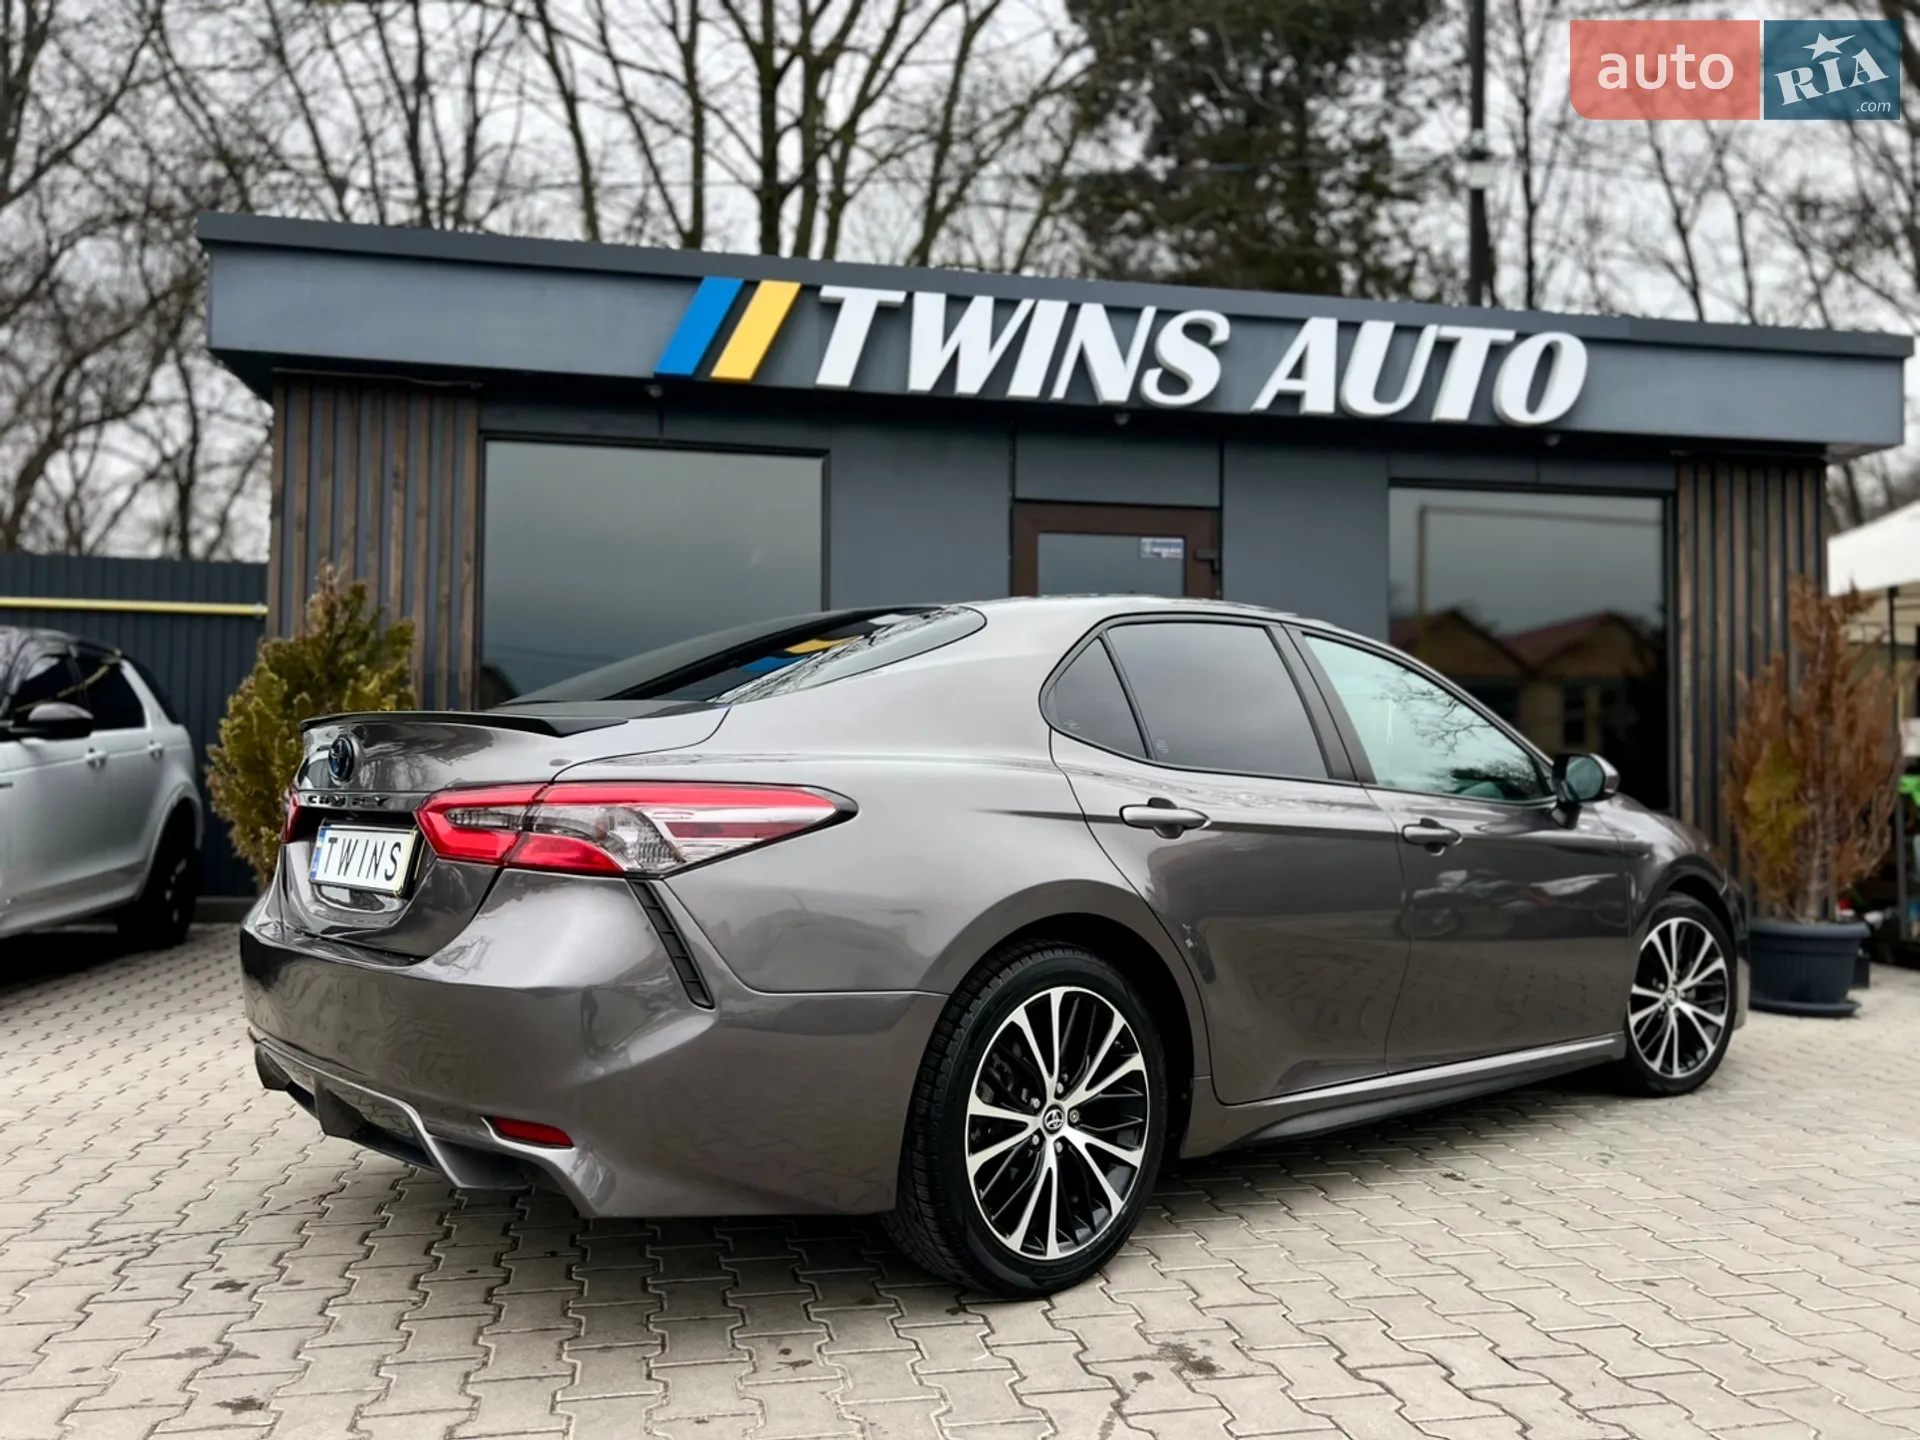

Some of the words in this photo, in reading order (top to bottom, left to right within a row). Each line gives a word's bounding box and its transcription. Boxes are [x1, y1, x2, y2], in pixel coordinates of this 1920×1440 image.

[815, 285, 1231, 408] TWINS
[1250, 316, 1588, 427] AUTO
[324, 837, 402, 882] TWINS
